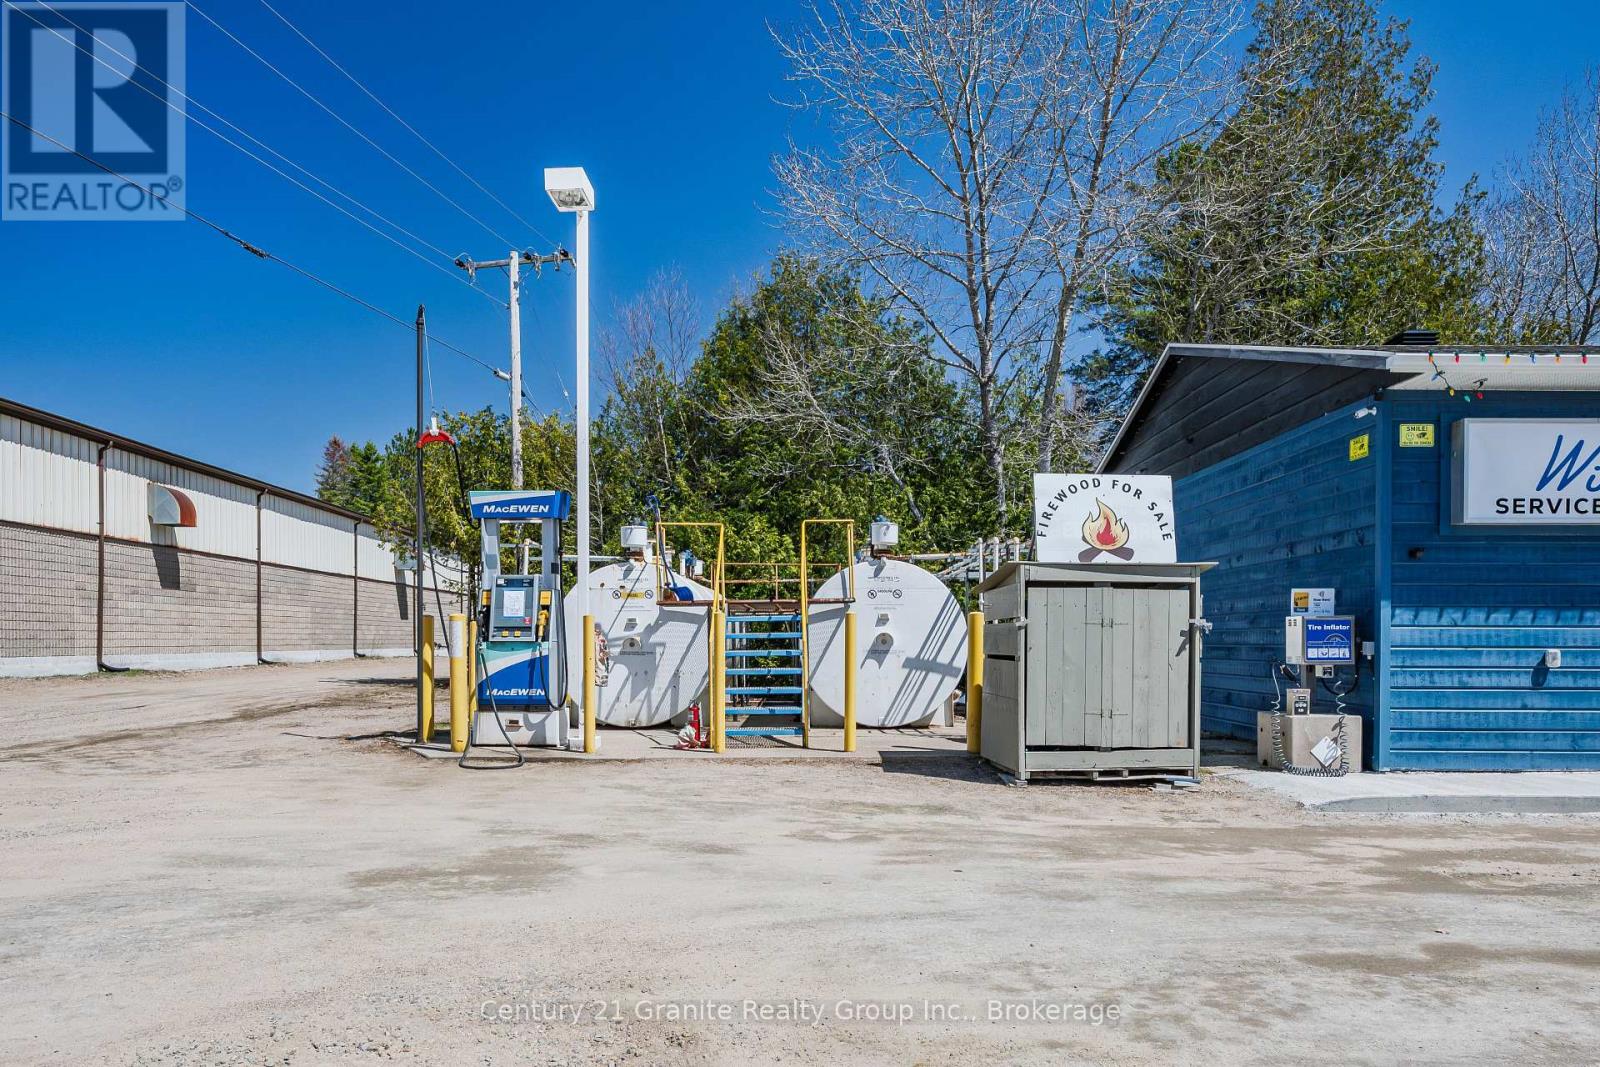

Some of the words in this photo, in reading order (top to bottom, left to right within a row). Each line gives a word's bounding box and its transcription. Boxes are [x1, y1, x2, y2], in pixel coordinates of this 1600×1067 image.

[1037, 478, 1101, 538] FIREWOOD
[1112, 479, 1143, 500] FOR
[1147, 501, 1173, 541] SALE
